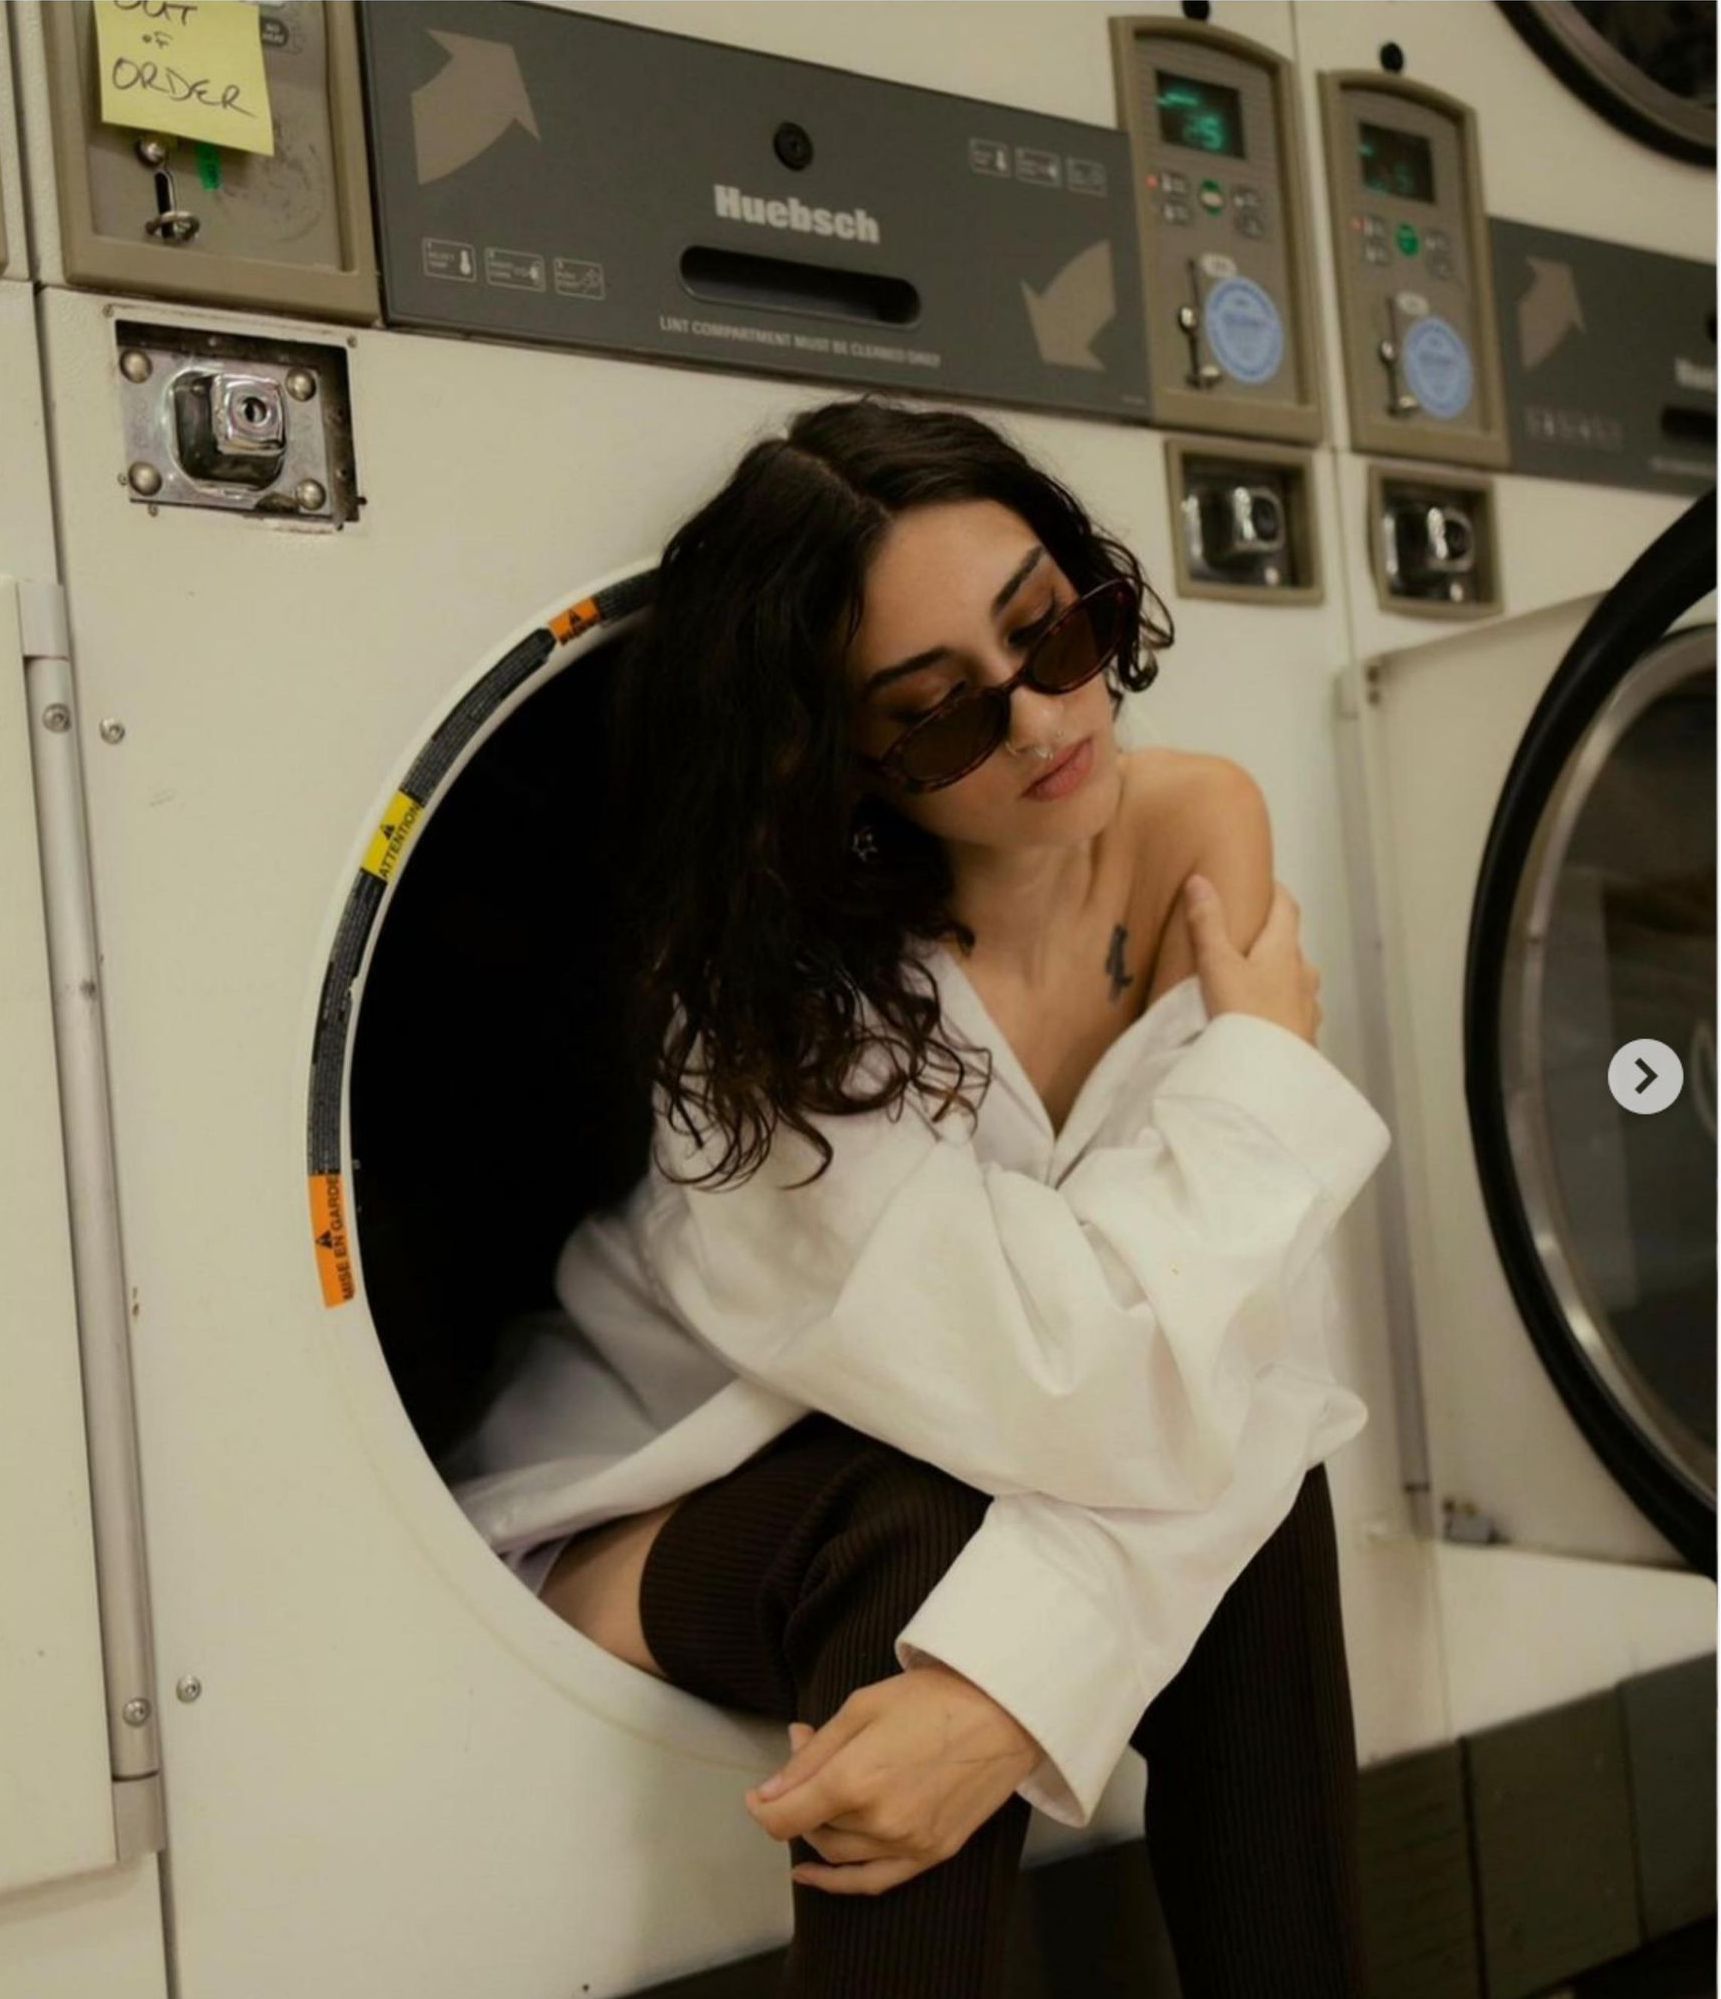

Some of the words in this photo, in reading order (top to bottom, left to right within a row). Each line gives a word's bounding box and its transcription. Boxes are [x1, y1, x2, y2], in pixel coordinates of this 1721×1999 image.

[112, 57, 257, 118] ORDER
[714, 184, 880, 244] Huebsch
[659, 316, 690, 333] LINT
[691, 320, 791, 348] COMPARTMENT
[794, 335, 829, 352] MUST
[832, 341, 848, 355] BE
[851, 343, 905, 363] CLEANED
[379, 802, 421, 878] ATTENTION
[326, 1175, 343, 1231] GARDE
[333, 1235, 347, 1258] EN
[336, 1261, 355, 1300] MISE
